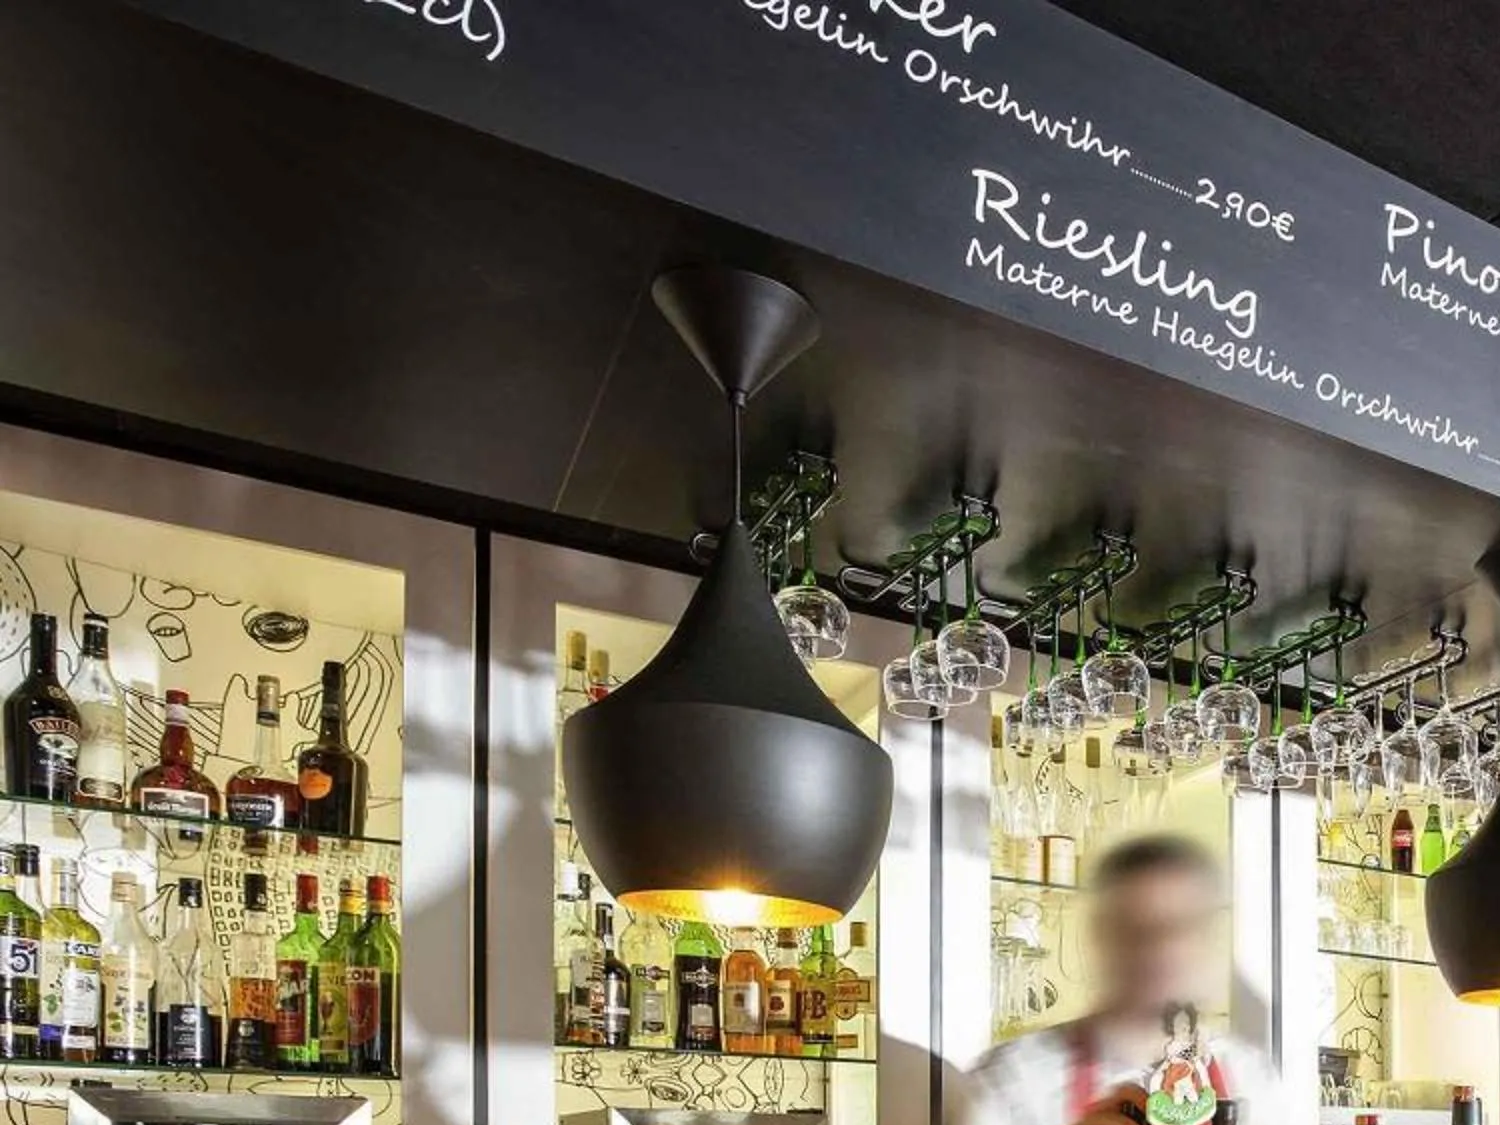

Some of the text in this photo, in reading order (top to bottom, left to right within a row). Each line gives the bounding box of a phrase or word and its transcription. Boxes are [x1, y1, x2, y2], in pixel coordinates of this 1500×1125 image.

[365, 0, 505, 61] cl)
[904, 49, 1131, 167] Orschwihr
[1196, 178, 1296, 243] 2,90€
[971, 168, 1259, 339] Riesling
[965, 238, 1138, 326] Materne
[1152, 310, 1304, 389] Haegelin
[1316, 374, 1479, 455] Orschwihr
